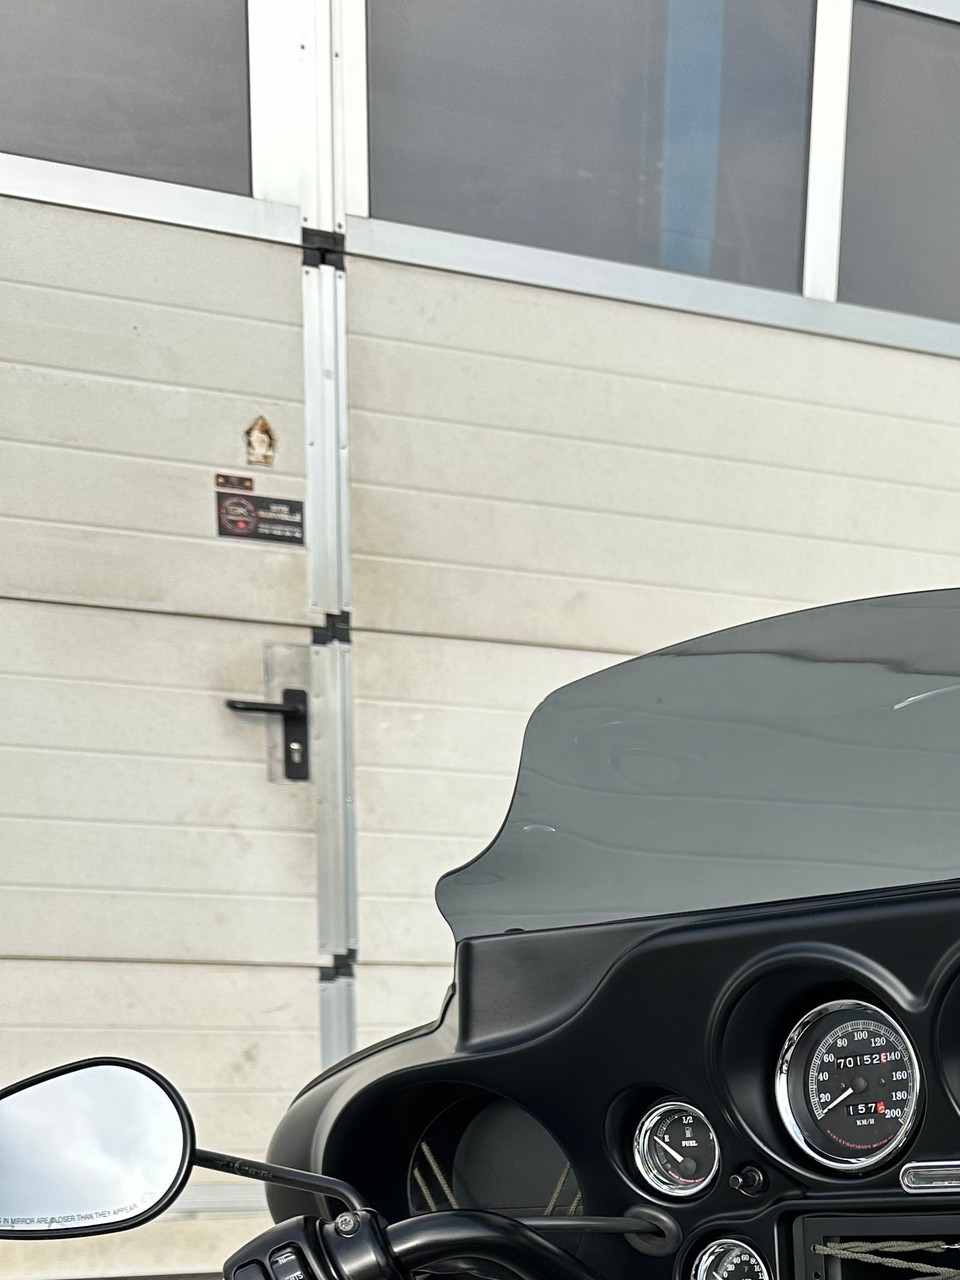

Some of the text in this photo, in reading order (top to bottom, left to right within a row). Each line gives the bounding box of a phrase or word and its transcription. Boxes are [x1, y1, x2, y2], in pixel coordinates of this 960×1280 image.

[853, 1031, 868, 1040] 100
[836, 1038, 848, 1047] 80
[870, 1037, 886, 1047] 120
[823, 1053, 834, 1062] 60
[887, 1051, 900, 1060] 140
[818, 1072, 829, 1081] 40
[892, 1071, 907, 1080] 160
[820, 1093, 831, 1102] 20
[891, 1091, 907, 1100] 180
[885, 1109, 901, 1118] 200
[682, 1116, 693, 1124] 1/2
[76, 1214, 94, 1222] THAN
[94, 1211, 111, 1219] THEY
[113, 1203, 138, 1215] APPEAR
